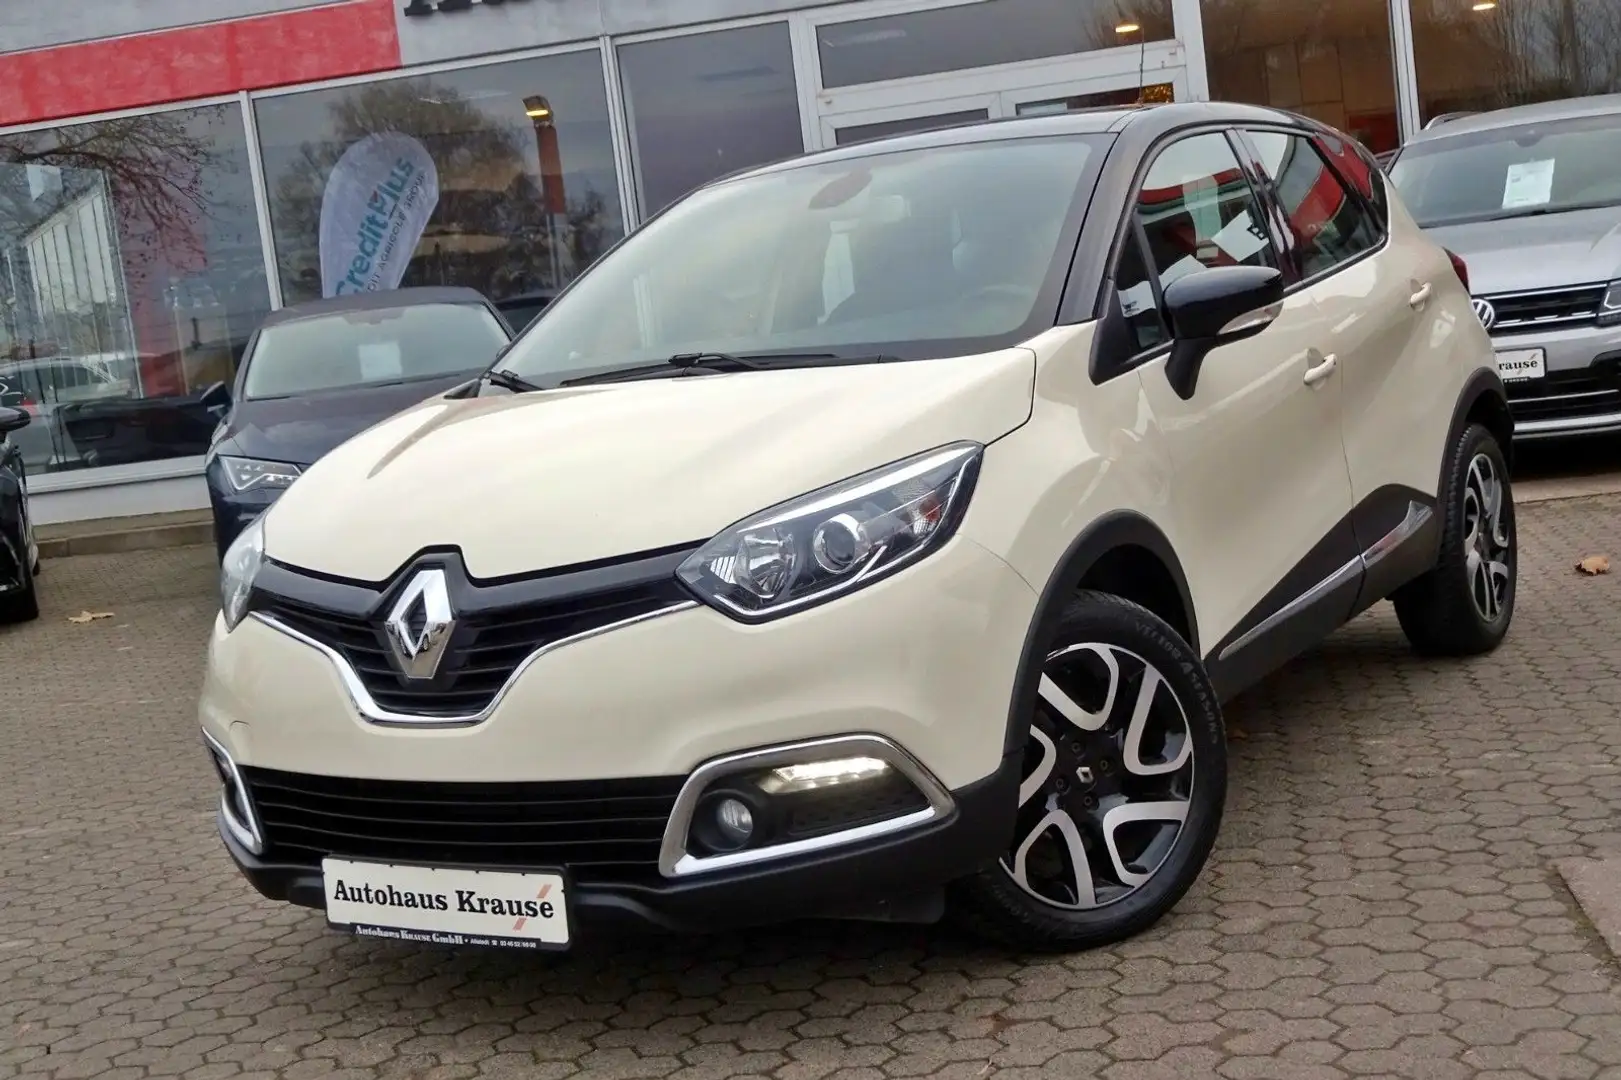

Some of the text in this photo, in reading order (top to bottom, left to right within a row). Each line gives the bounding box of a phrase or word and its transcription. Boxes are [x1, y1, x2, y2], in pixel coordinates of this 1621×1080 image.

[1498, 360, 1538, 371] rause
[334, 880, 554, 918] Autohaus Krause
[355, 924, 401, 939] Autohaus
[431, 932, 464, 945] GmbH
